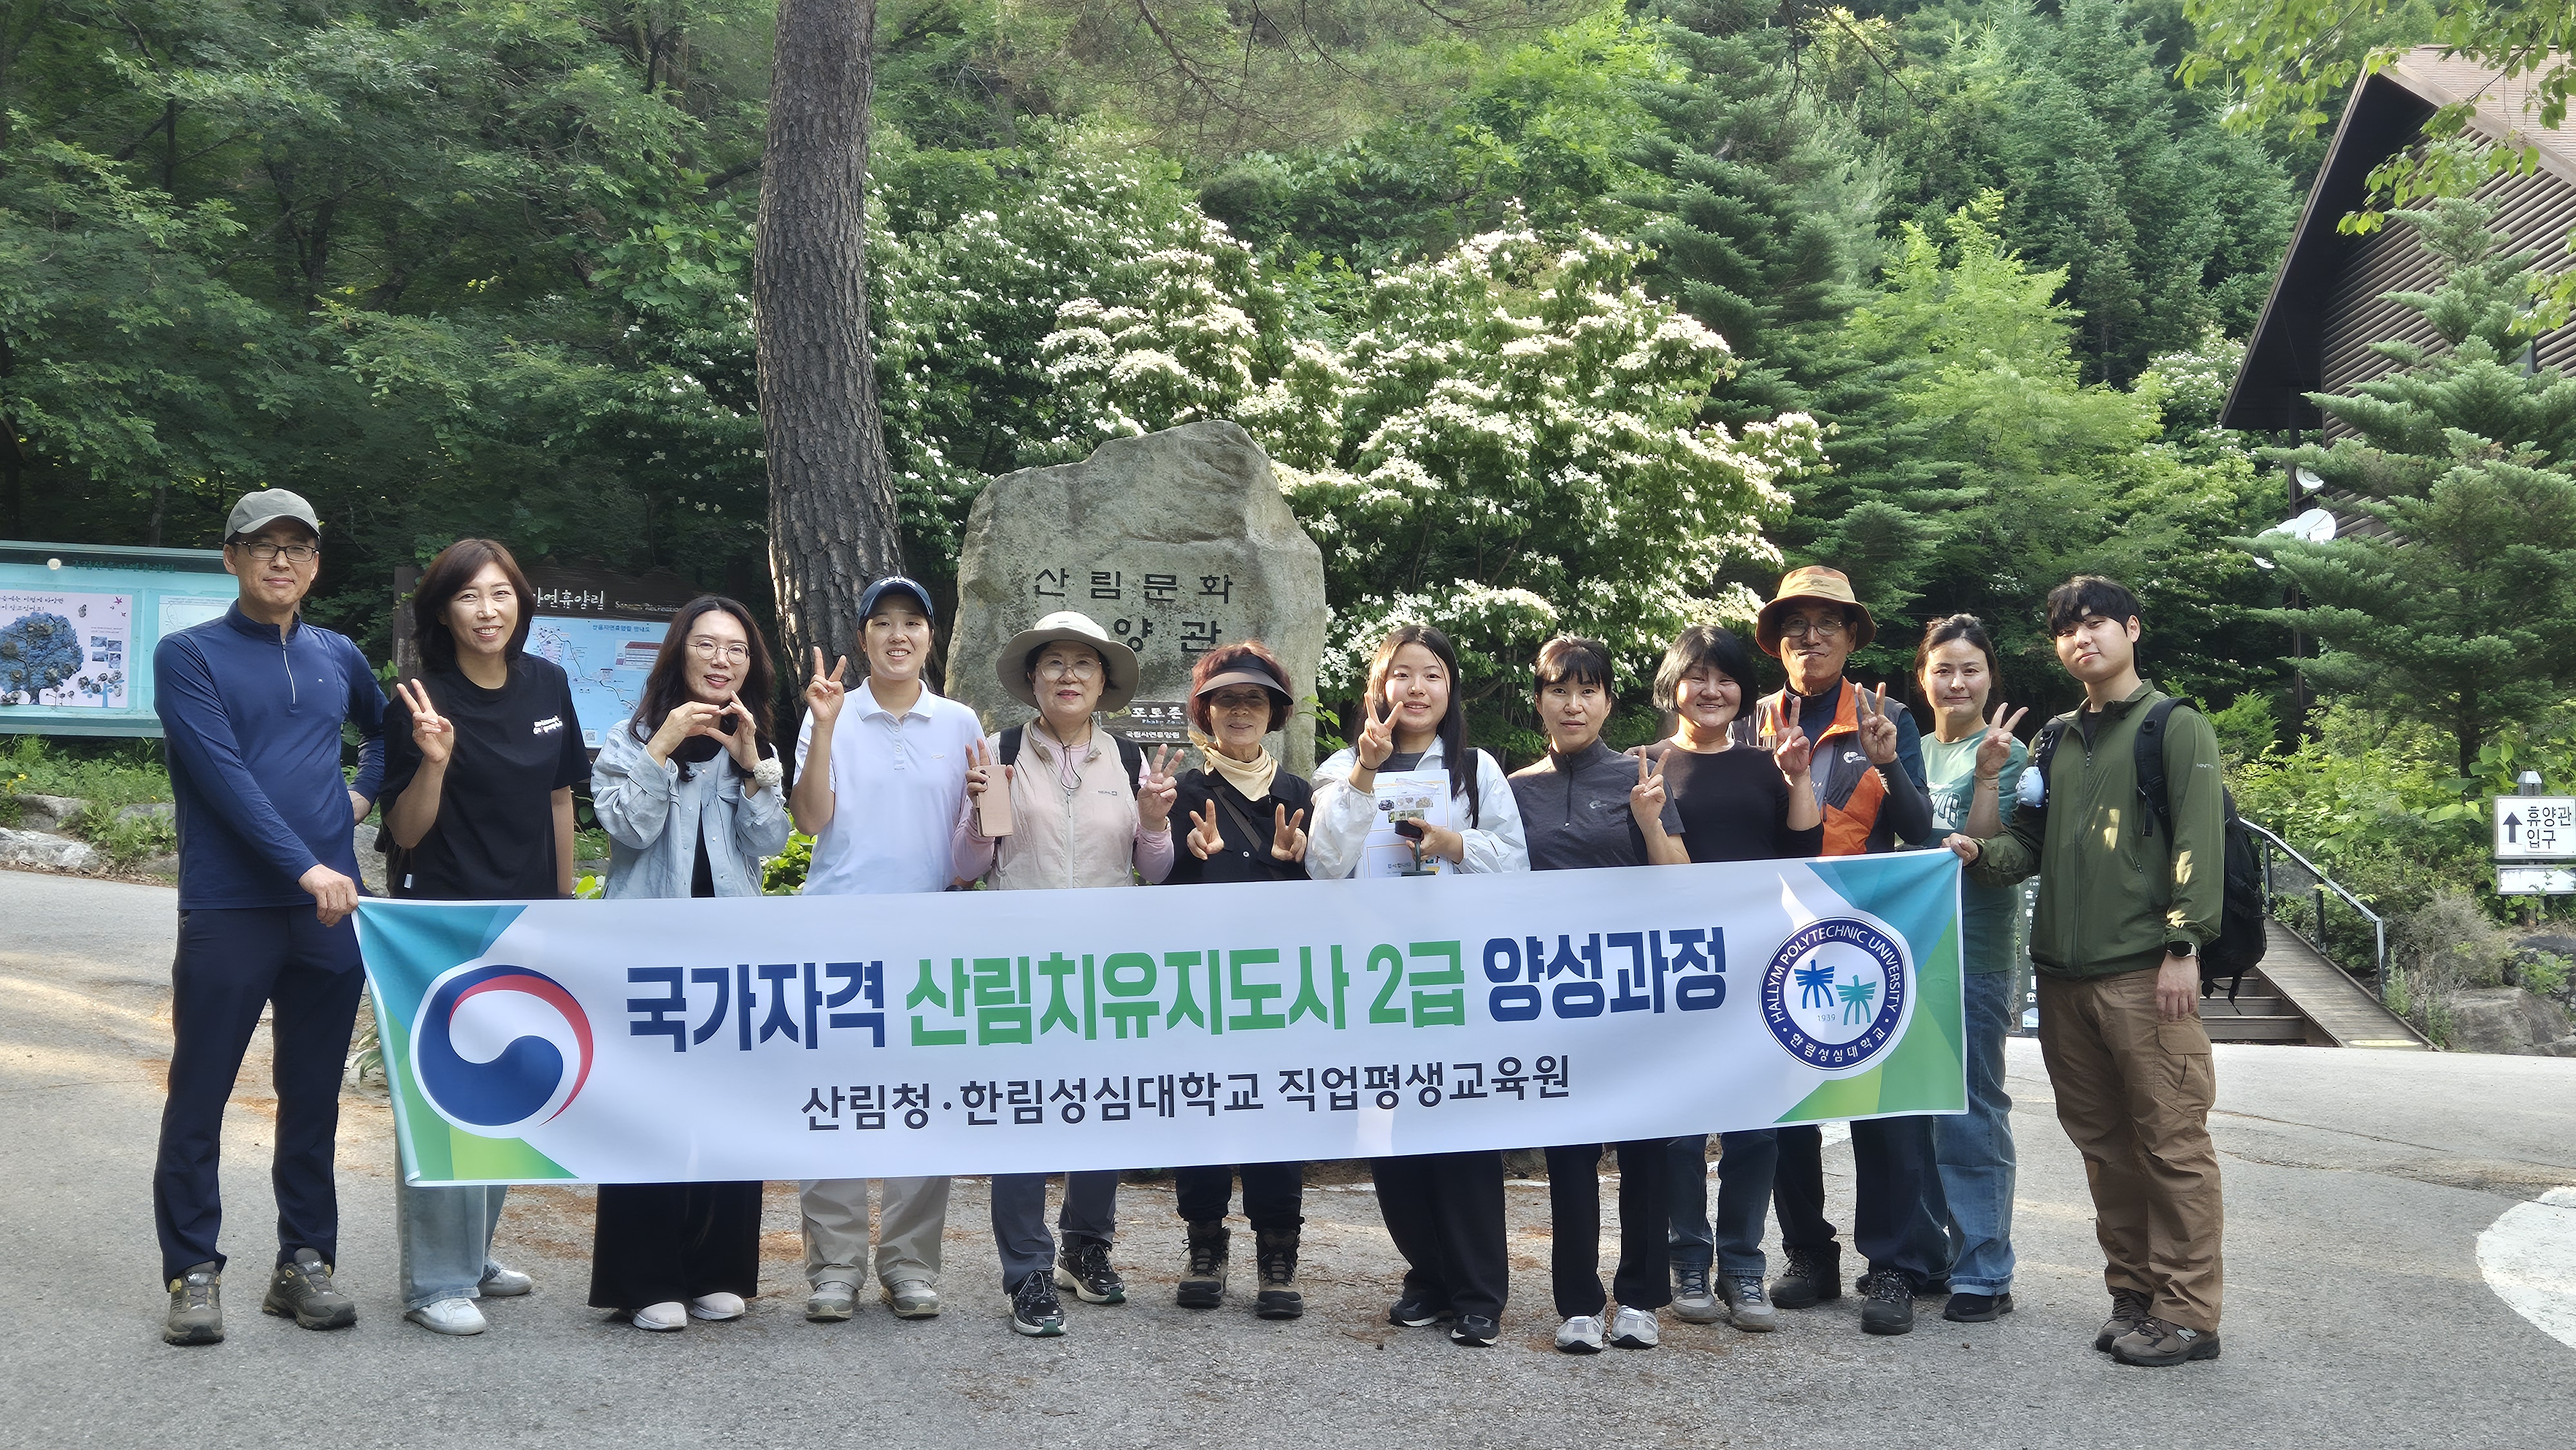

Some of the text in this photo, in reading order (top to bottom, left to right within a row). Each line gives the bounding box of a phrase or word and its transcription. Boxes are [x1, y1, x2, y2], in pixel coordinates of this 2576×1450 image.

[1034, 568, 1233, 604] 산림문화
[1113, 618, 1222, 653] 양관
[1131, 706, 1184, 719] 포토존
[2526, 806, 2572, 827] 휴양관
[2527, 829, 2556, 849] 입구
[627, 927, 1727, 1053] 국가자격 산림치유지도사 2급 양성과정
[1766, 925, 1900, 1023] HALLYM POLYTECHNIC UNIVERSITY
[1790, 1028, 1886, 1062] 한림성심대학교
[1278, 1055, 1570, 1113] 직업평생교육원
